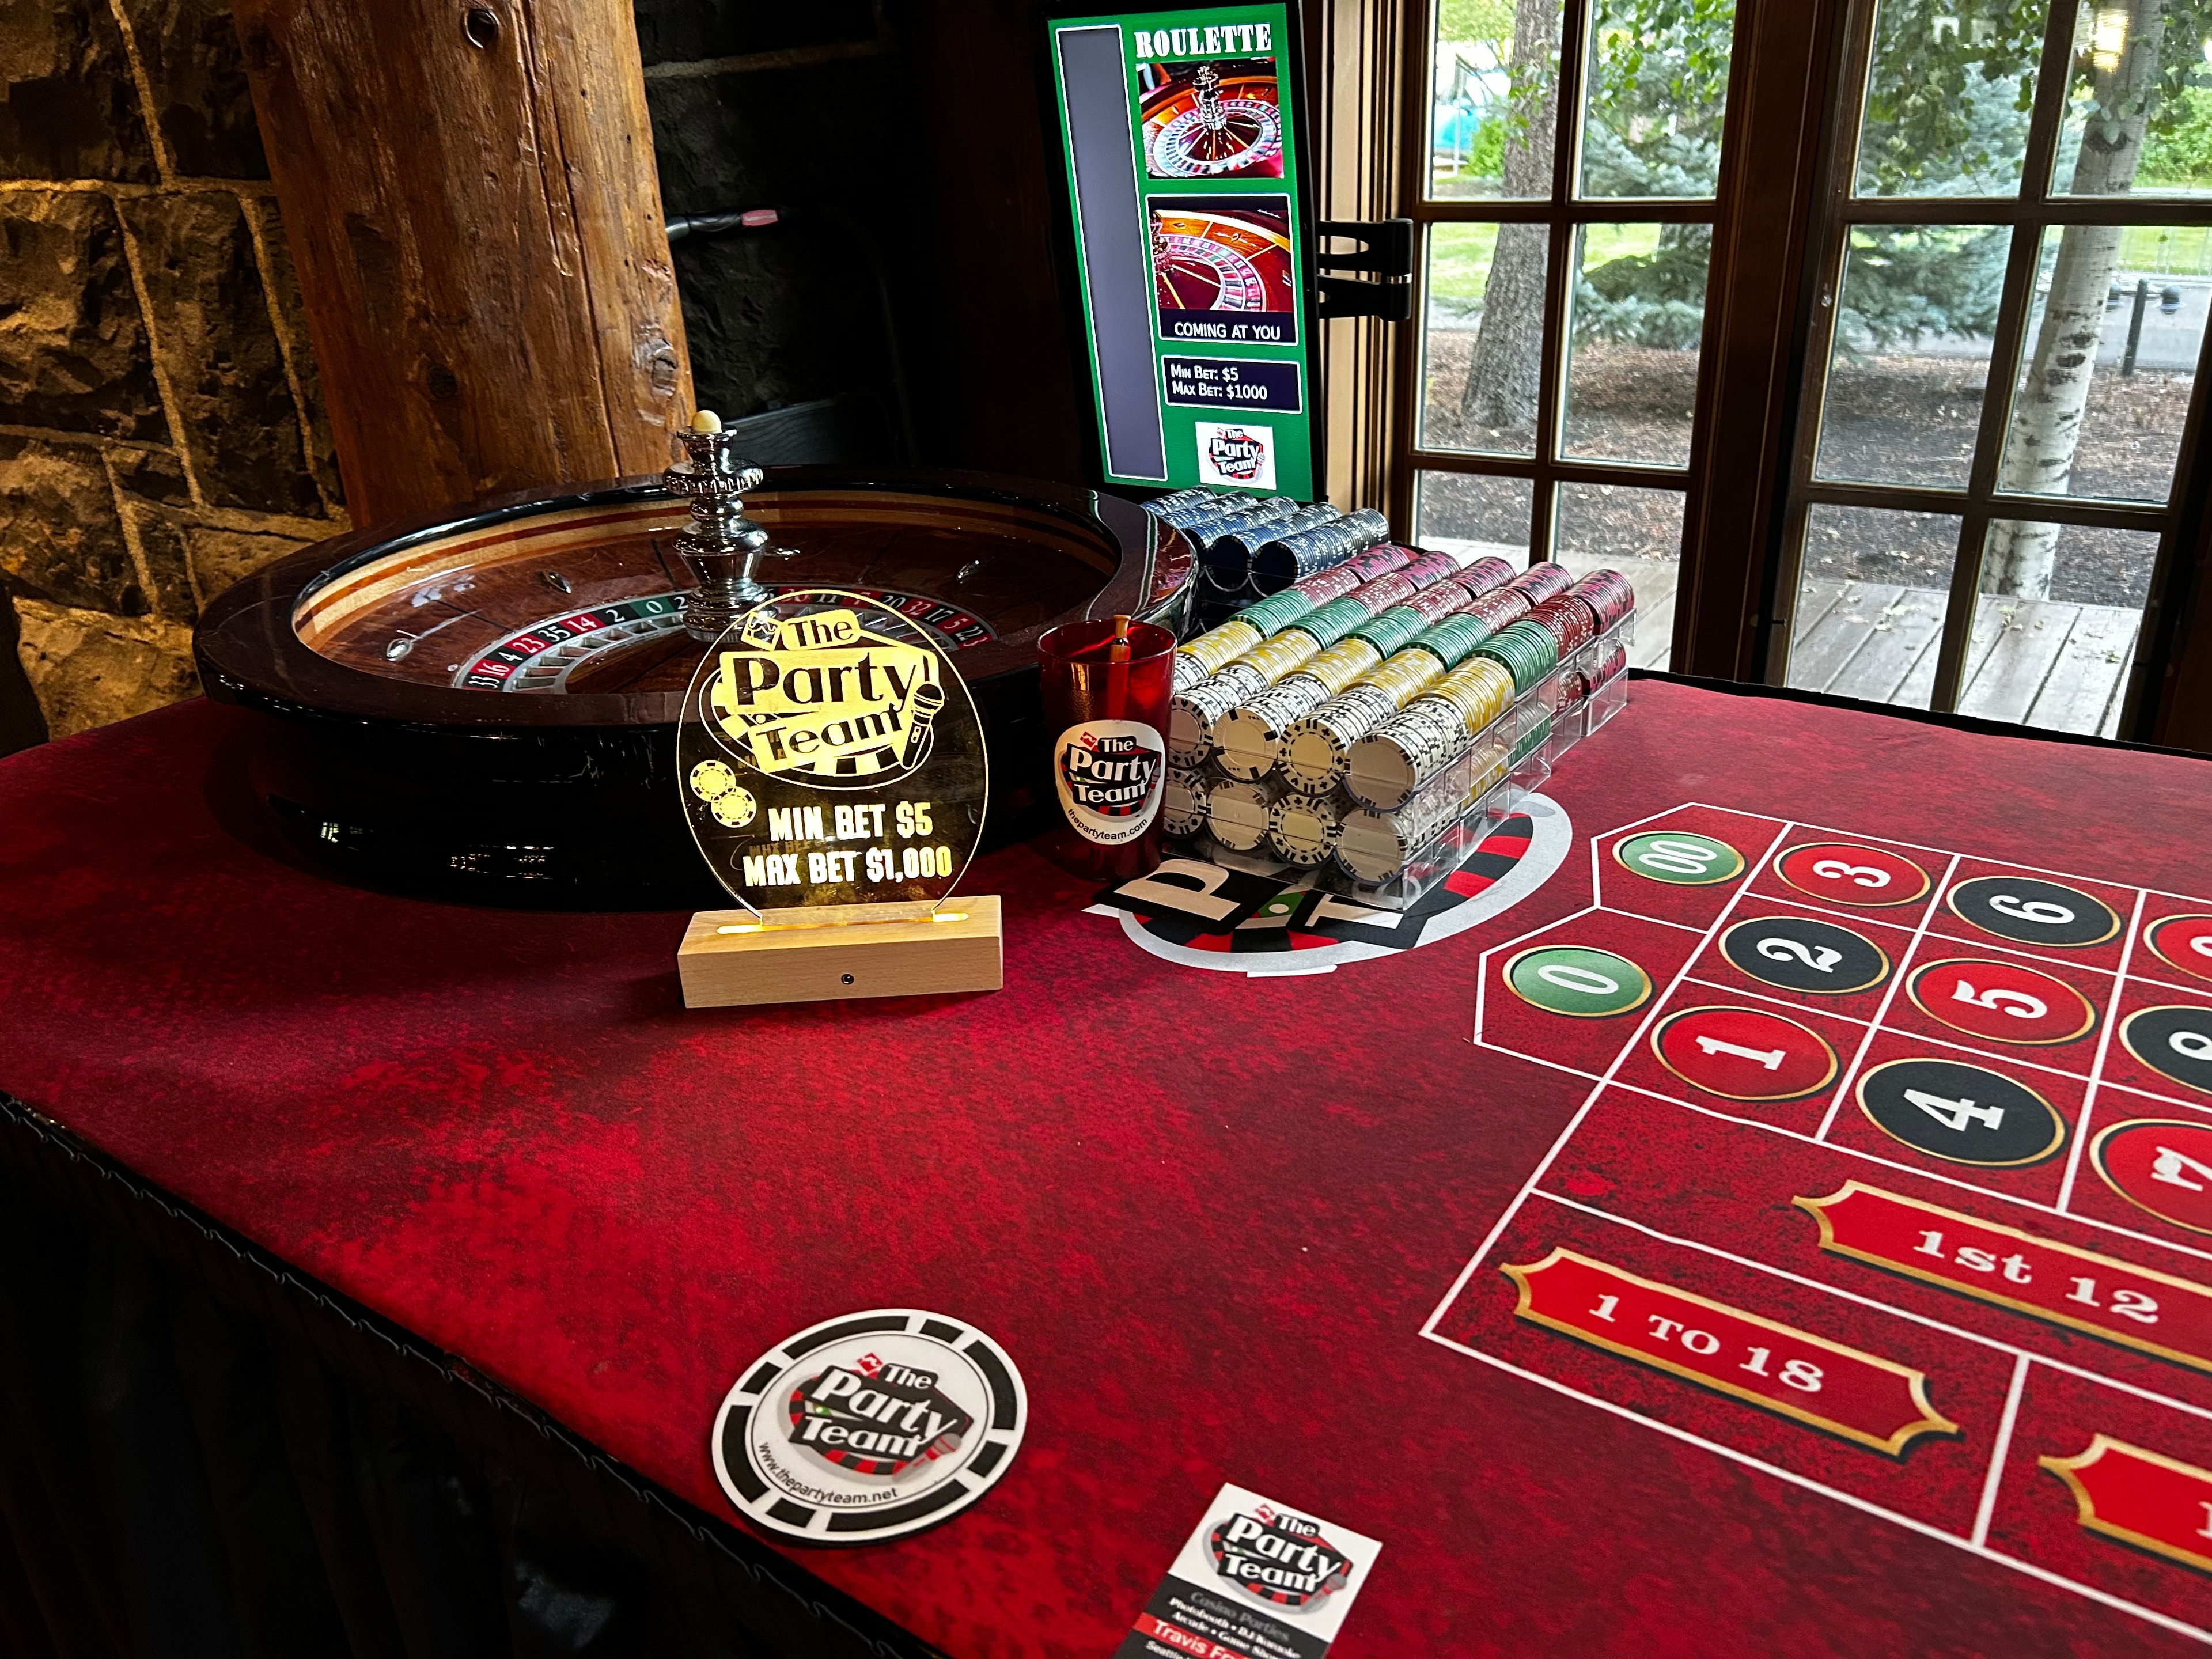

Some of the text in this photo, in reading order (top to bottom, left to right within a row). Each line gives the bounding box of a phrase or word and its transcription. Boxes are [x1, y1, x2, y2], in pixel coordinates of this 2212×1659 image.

[1134, 23, 1272, 58] ROULETTE
[1174, 322, 1281, 340] COMING AT YOU
[1222, 366, 1238, 382] $5
[1226, 384, 1267, 400] $1000
[1226, 430, 1243, 439] The
[1212, 439, 1259, 462] Party
[1218, 459, 1256, 474] Team
[605, 609, 626, 623] 2
[646, 600, 663, 613] 0
[902, 601, 931, 616] 32
[924, 608, 955, 622] 17
[538, 626, 571, 642] 35
[567, 616, 597, 632] 14
[788, 620, 854, 647] The
[944, 618, 969, 629] 5
[955, 626, 983, 641] 22
[498, 652, 523, 661] 4
[513, 637, 546, 654] 23
[468, 676, 500, 689] 33
[477, 662, 510, 676] 16
[732, 653, 917, 711] Party
[755, 711, 904, 762] Team
[1101, 738, 1134, 752] The
[1070, 747, 1156, 784] Party
[1074, 781, 1146, 802] Team
[768, 801, 933, 841] MIN BET $5
[1068, 809, 1147, 840] thepartyteam.com
[743, 854, 801, 887] MAX
[808, 850, 858, 884] BET
[865, 846, 952, 882] $1,000
[1638, 840, 1717, 874] 00
[1813, 859, 1891, 888] 3
[1988, 895, 2075, 923] 6
[1756, 937, 1842, 974] 2
[1537, 964, 1619, 995] 0
[1951, 979, 2047, 1018] 5
[1695, 1035, 1786, 1070] 1
[1904, 1088, 2005, 1131] 4
[1913, 1230, 2159, 1324] 1st 12
[1588, 1293, 1824, 1392] 1 TO 18
[885, 1365, 932, 1389] The
[811, 1368, 958, 1445] Party
[802, 1416, 921, 1457] Team
[759, 1442, 898, 1503] www.thepartyteam.net
[1279, 1516, 1316, 1537] The
[1226, 1516, 1342, 1583] Party
[1225, 1553, 1316, 1592] Team
[1190, 1592, 1289, 1641] Casino Parties
[1154, 1619, 1207, 1654] Travis
